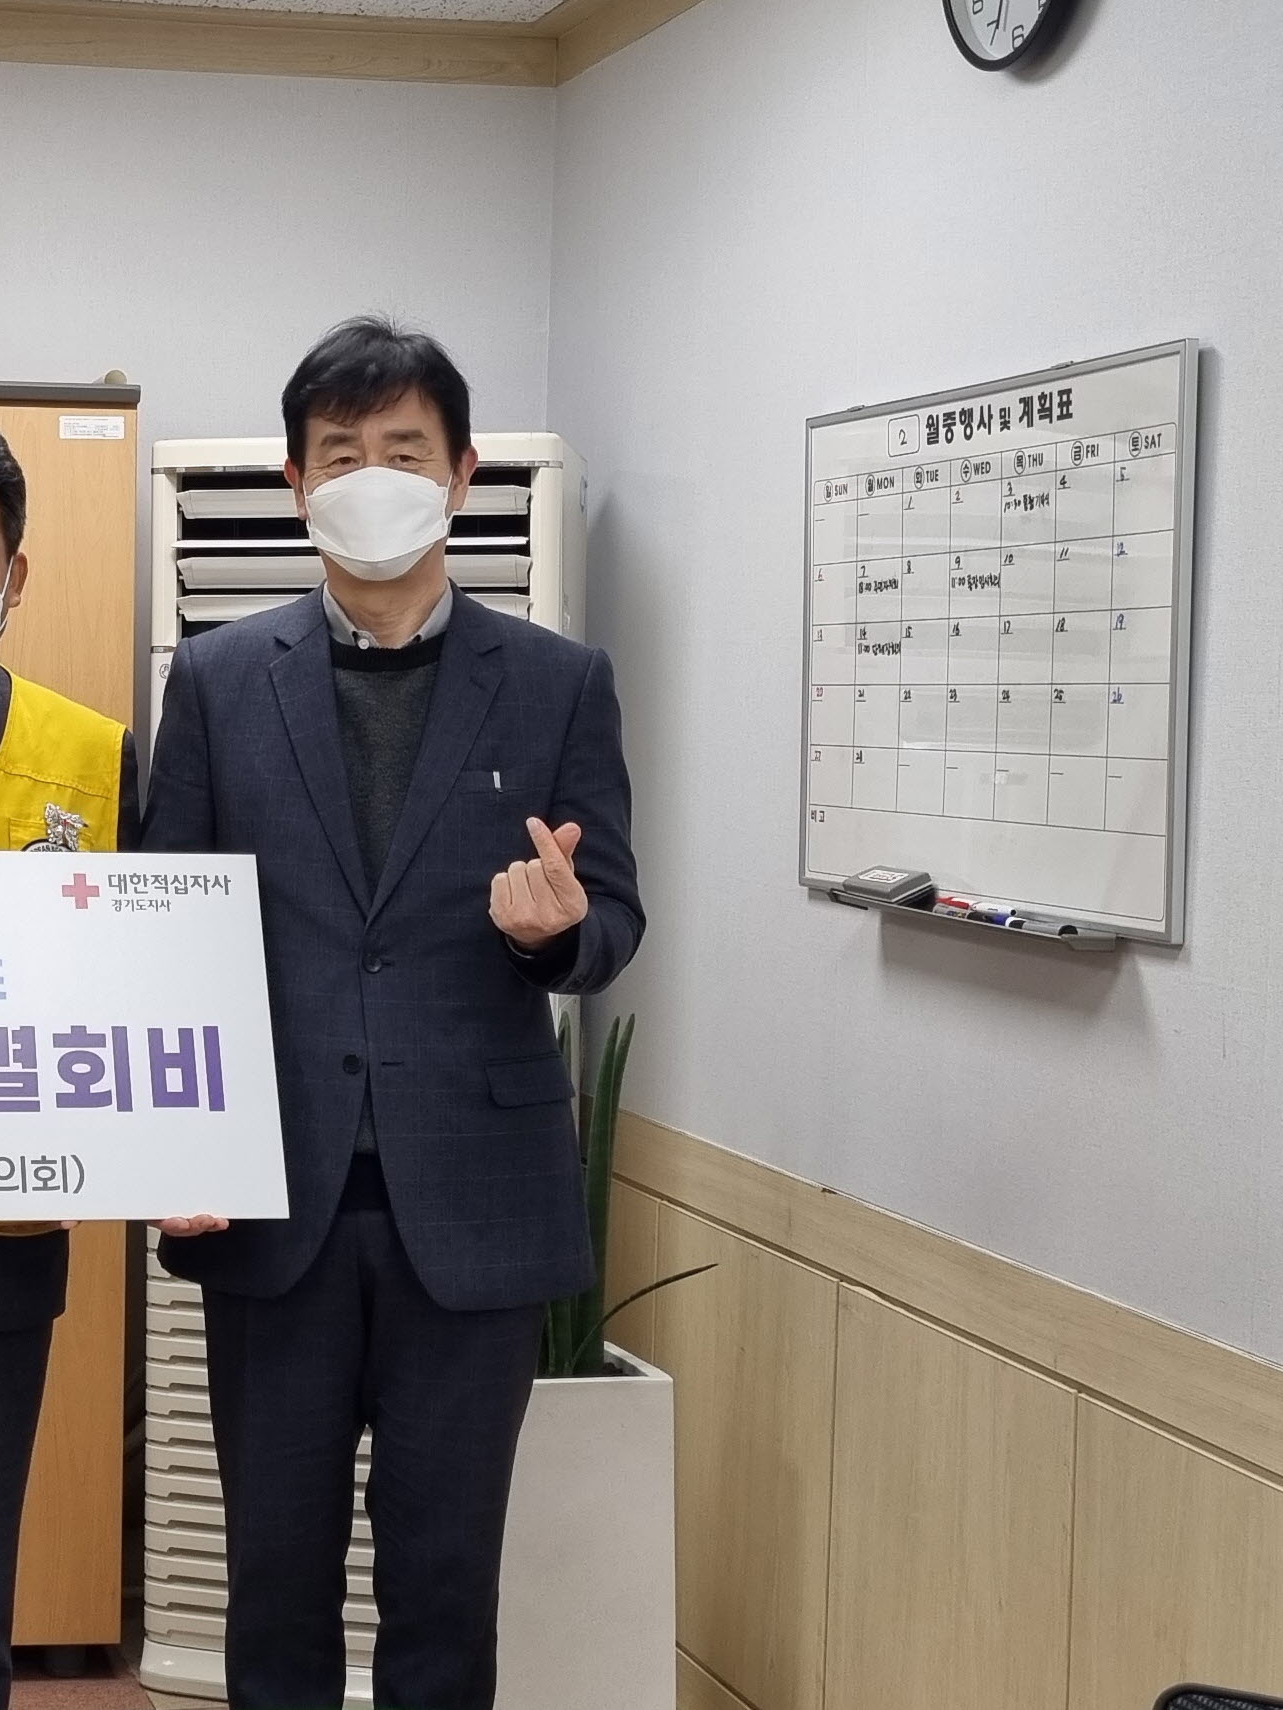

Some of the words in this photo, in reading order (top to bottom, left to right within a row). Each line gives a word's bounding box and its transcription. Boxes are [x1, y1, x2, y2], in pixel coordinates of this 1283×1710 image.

[987, 20, 1000, 46] 7
[1012, 25, 1025, 50] 6
[925, 404, 994, 446] 월중행사
[999, 406, 1011, 433] 및
[1018, 388, 1073, 428] 계획표
[898, 428, 908, 446] 2
[1144, 432, 1162, 450] SAT
[1085, 443, 1100, 459] FRI
[1027, 452, 1044, 468] THU
[925, 469, 939, 484] TUE
[973, 461, 992, 476] WED
[834, 484, 848, 497] SUN
[876, 476, 895, 490] MON
[1003, 553, 1014, 564] 10
[1060, 547, 1069, 559] 11
[107, 872, 232, 895] 대한적십자사
[111, 899, 172, 912] 경기도지사
